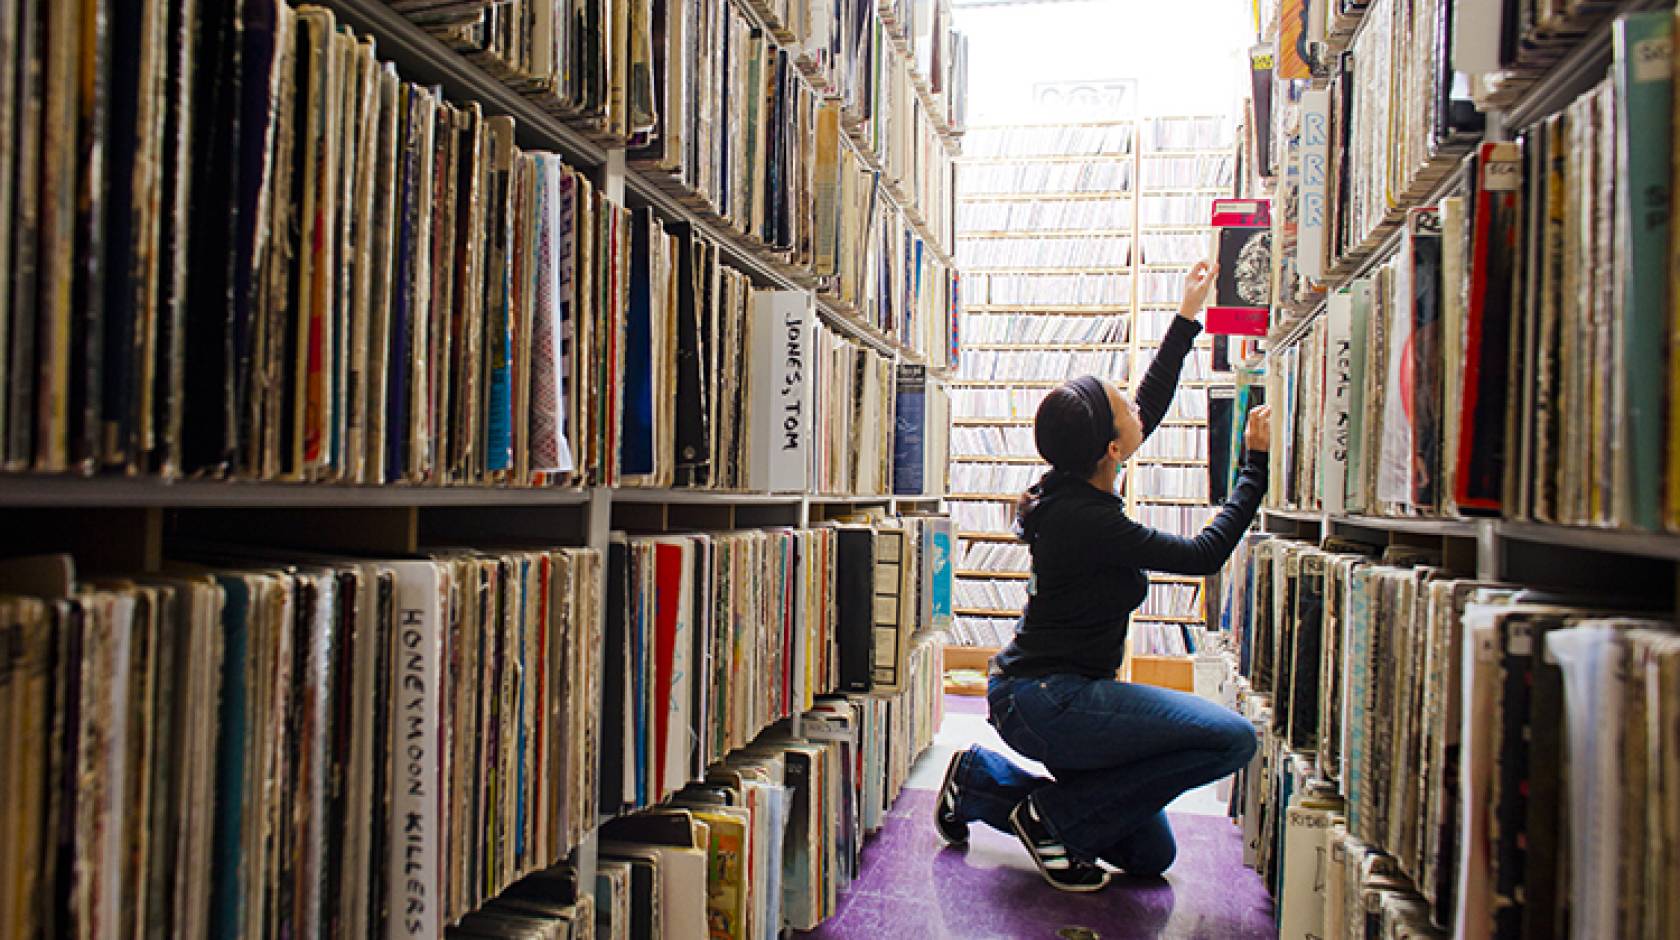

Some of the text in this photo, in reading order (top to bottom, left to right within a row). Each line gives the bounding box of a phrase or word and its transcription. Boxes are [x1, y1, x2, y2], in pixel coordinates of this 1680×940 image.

[782, 313, 803, 450] JONES, TOM
[403, 609, 425, 936] HONEYMOON KILLERS
